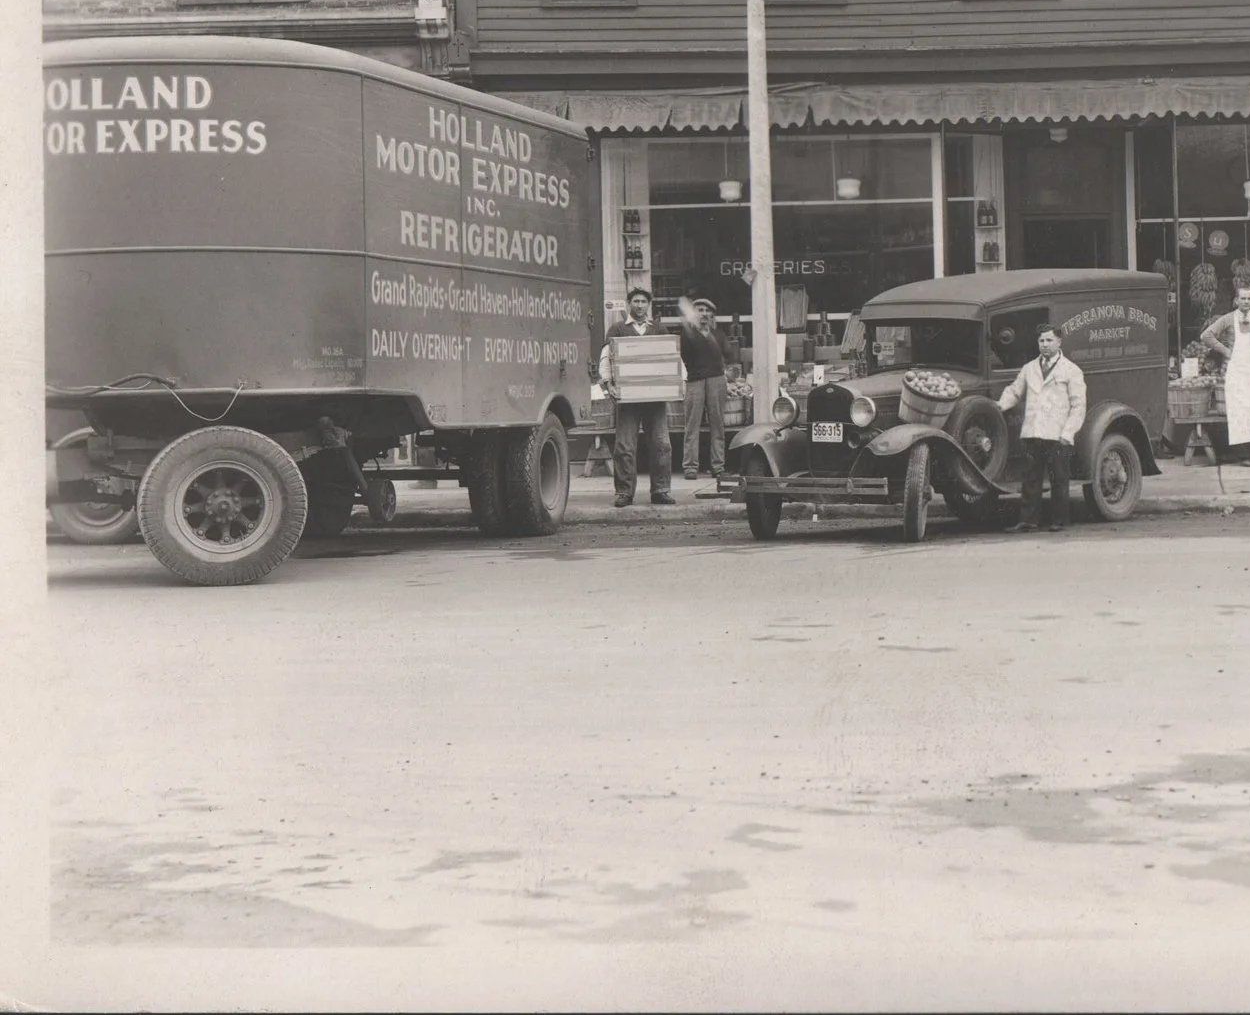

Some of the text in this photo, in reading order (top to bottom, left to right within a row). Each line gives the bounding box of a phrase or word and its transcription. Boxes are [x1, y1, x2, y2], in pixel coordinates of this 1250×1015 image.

[45, 118, 268, 155] OR EXPRESS
[428, 106, 532, 164] HOLLAND
[376, 134, 570, 209] MOTOR EXPRESS
[466, 196, 501, 217] INC.
[400, 209, 559, 267] REFRIGERATOR
[720, 259, 825, 276] GRERIES
[371, 269, 407, 308] Grand
[1061, 305, 1126, 337] TERRANOVA
[1089, 326, 1131, 343] MARKET
[371, 328, 408, 358] DAILY
[484, 337, 514, 364] EVERY
[516, 339, 540, 365] LOAD
[543, 341, 579, 365] INSURED
